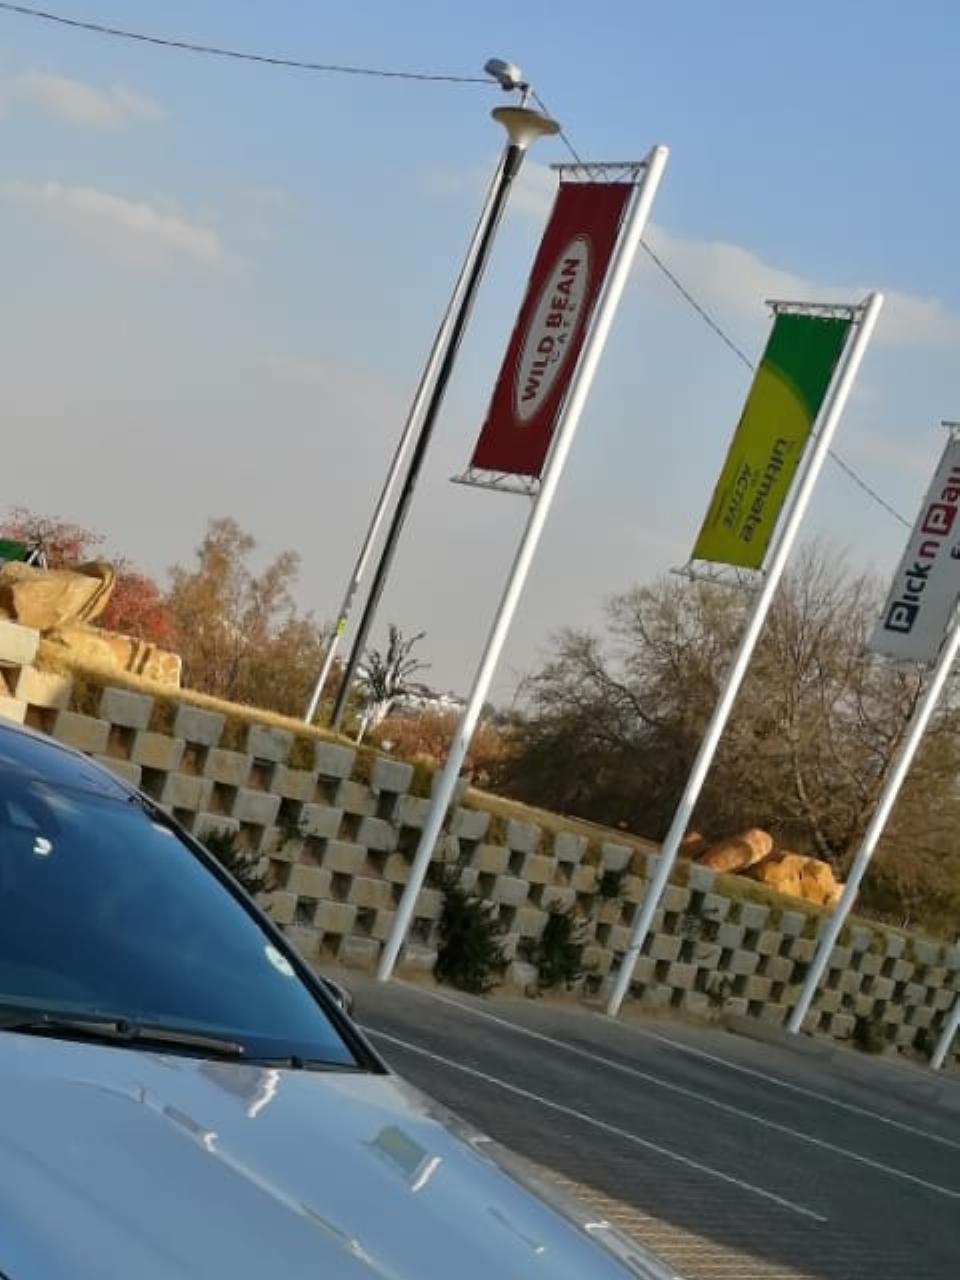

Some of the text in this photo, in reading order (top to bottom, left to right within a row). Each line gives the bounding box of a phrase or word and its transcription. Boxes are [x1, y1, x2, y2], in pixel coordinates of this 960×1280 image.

[522, 259, 580, 401] WILD BEAN
[884, 562, 932, 634] Pick
[919, 541, 940, 558] n
